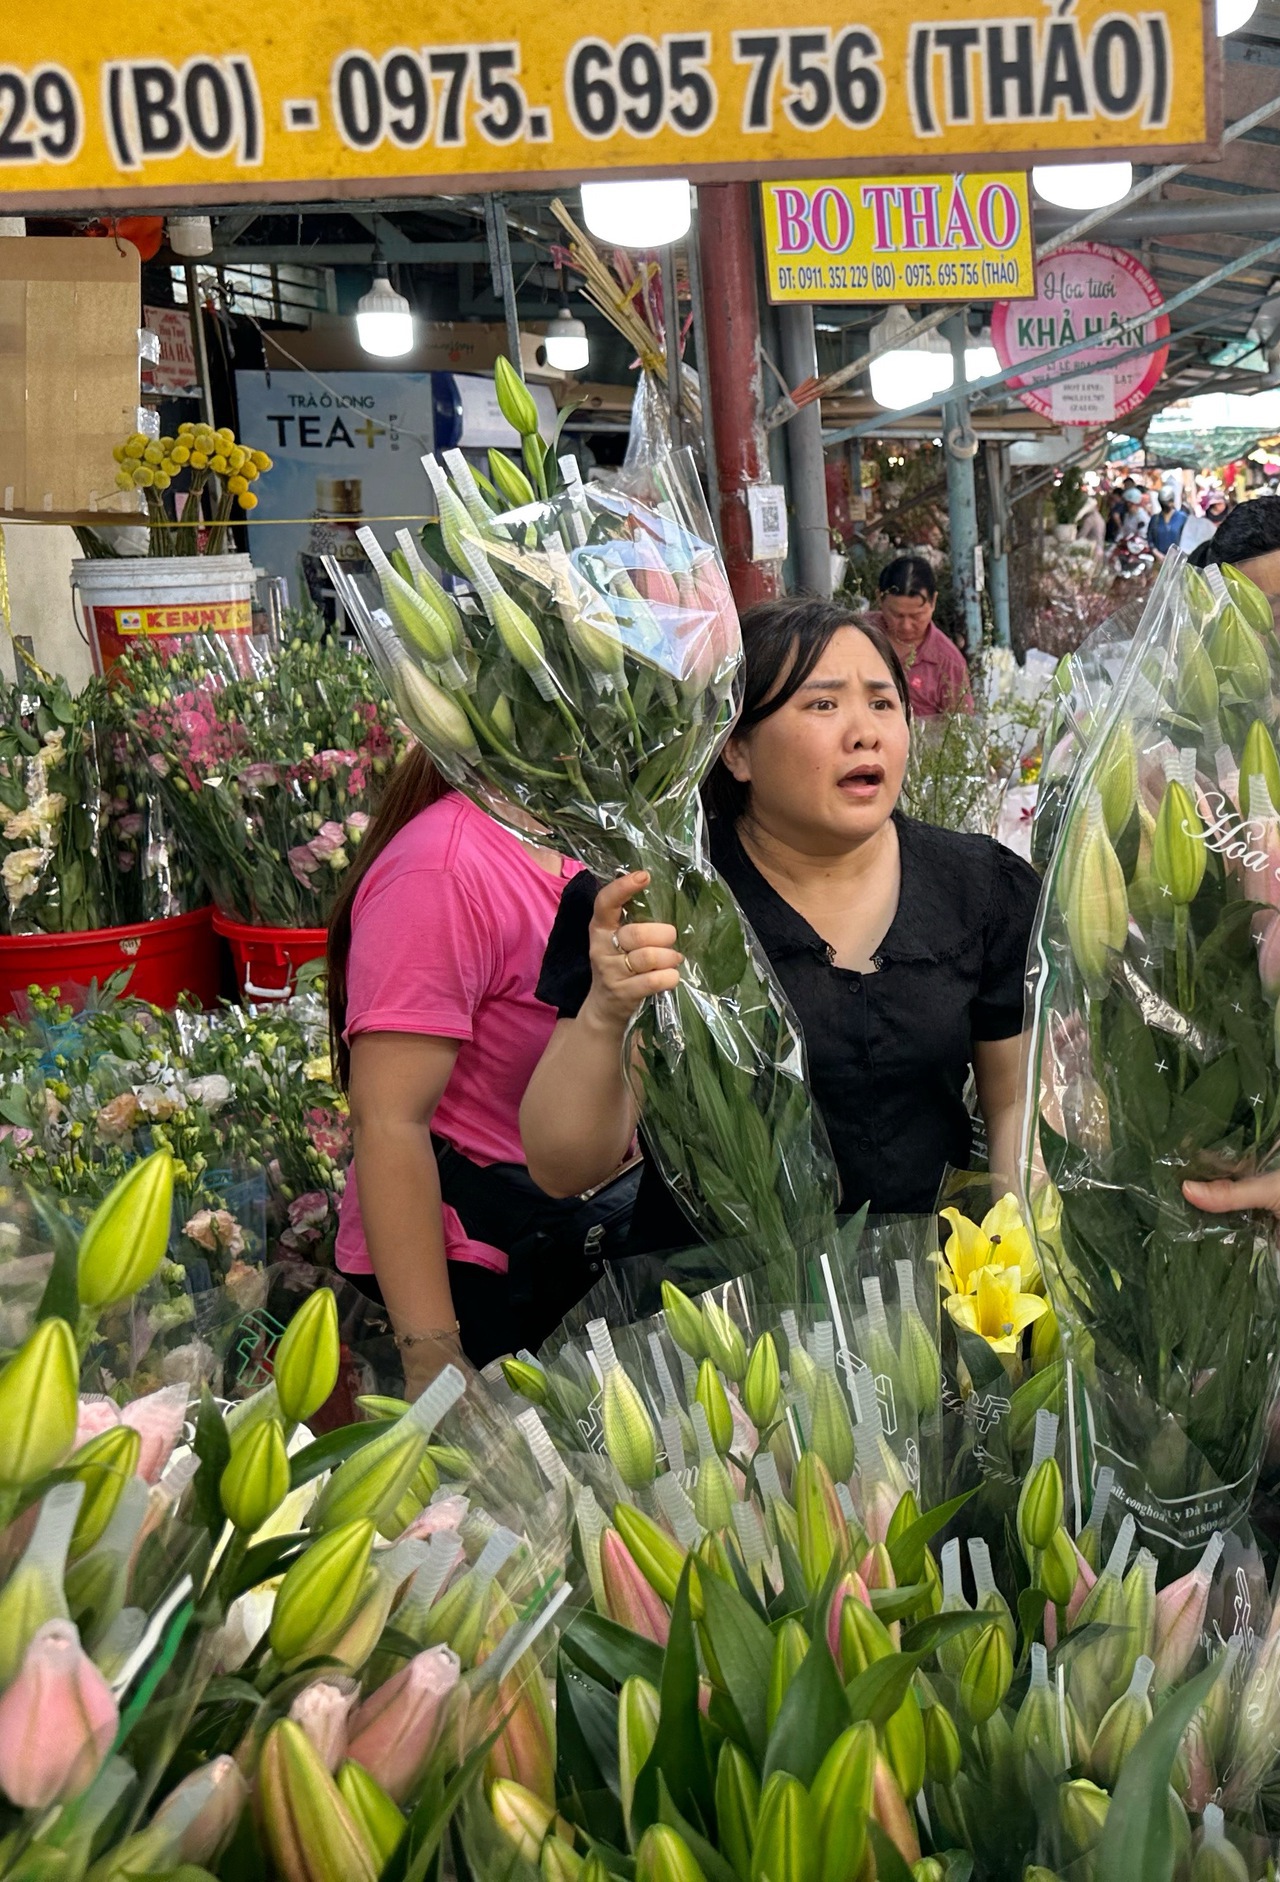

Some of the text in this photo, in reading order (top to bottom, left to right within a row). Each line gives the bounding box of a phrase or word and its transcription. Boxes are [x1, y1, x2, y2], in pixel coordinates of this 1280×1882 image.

[0, 68, 80, 162] 29
[106, 58, 261, 169] (BO)
[336, 47, 549, 147] 0975.
[570, 37, 716, 137] 695
[735, 30, 884, 128] 756
[772, 187, 853, 253] BO
[779, 269, 796, 290] ĐT:
[798, 267, 826, 288] 0911.
[829, 266, 848, 288] 352
[850, 265, 868, 288] 229
[872, 262, 895, 291] (BO)
[905, 264, 935, 287] 0975.
[938, 263, 957, 286] 695
[960, 263, 979, 285] 756
[982, 254, 1019, 288] (THẢO)
[1043, 271, 1117, 303] Hoa tươi
[1017, 309, 1076, 347] KHẢ
[287, 391, 319, 408] TRÀ
[335, 395, 376, 409] LONG
[146, 608, 230, 630] KENNY
